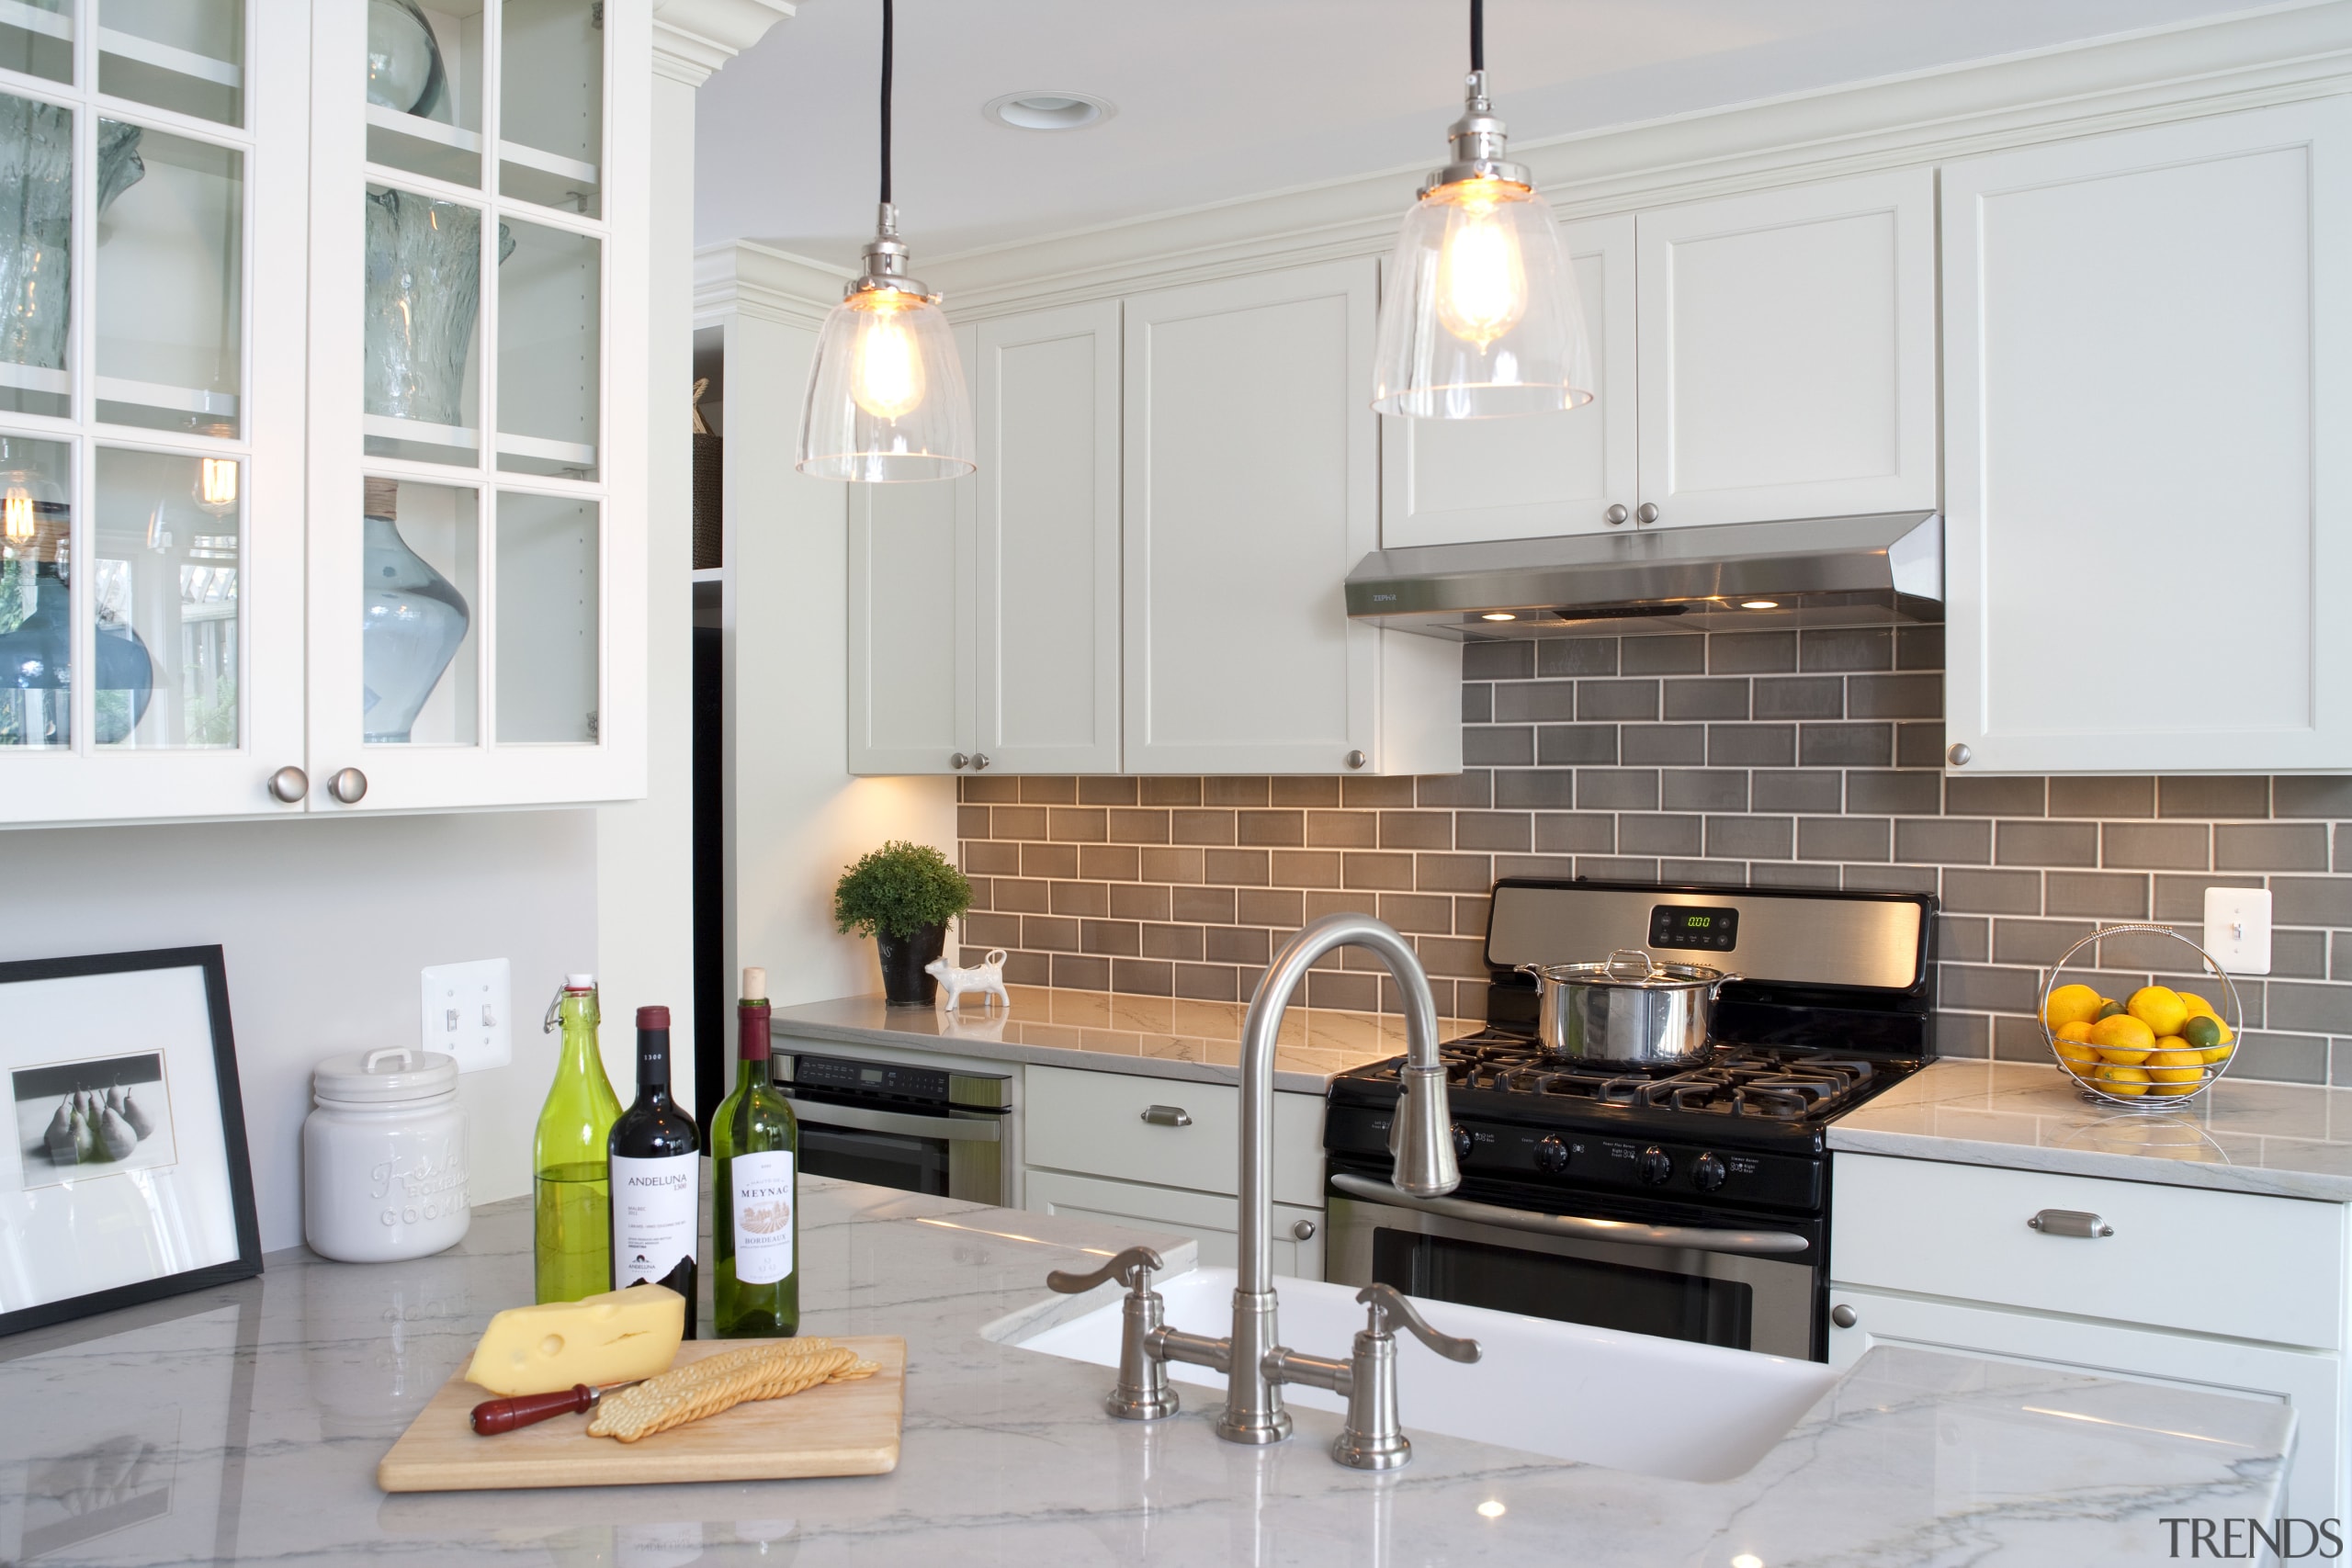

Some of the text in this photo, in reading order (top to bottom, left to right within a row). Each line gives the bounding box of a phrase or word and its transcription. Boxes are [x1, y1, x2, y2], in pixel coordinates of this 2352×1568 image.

[644, 1053, 662, 1061] 1300
[628, 1174, 687, 1187] ANDELUNA
[741, 1185, 788, 1198] MEYNAC
[744, 1234, 786, 1245] BORDEAUX
